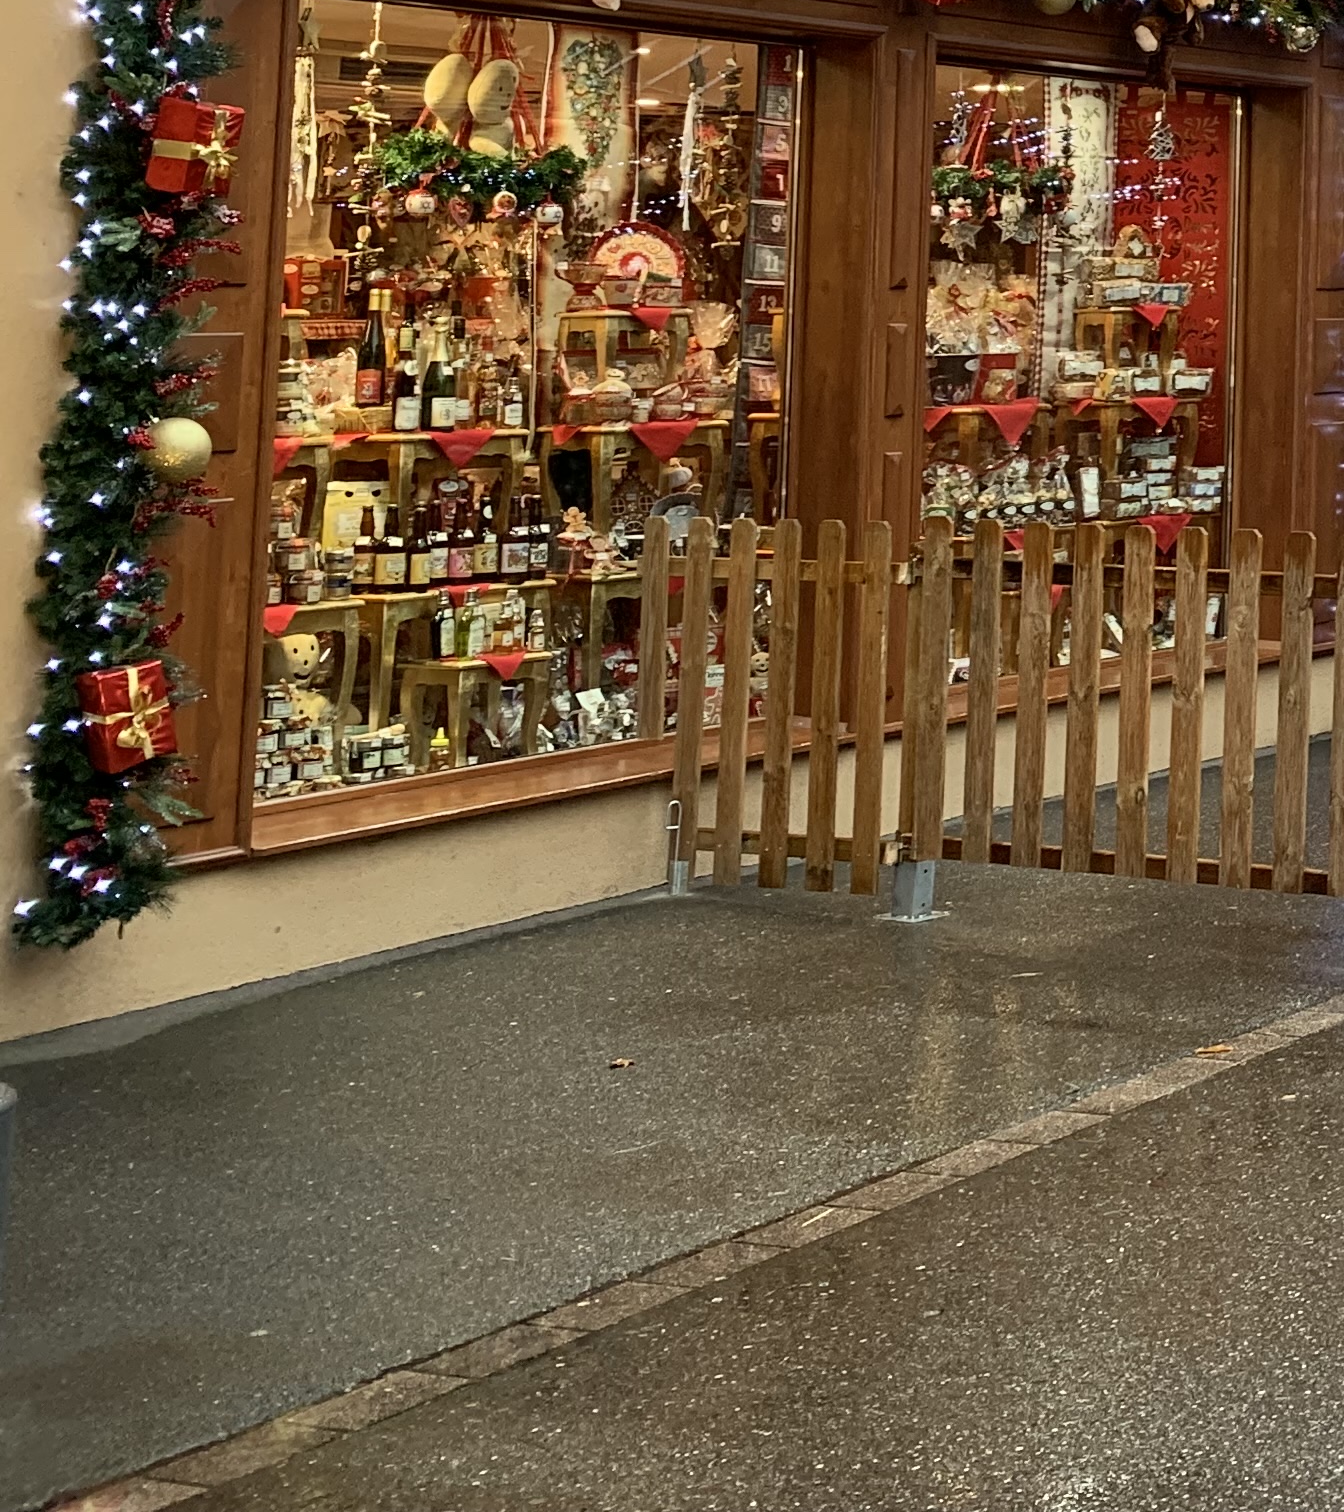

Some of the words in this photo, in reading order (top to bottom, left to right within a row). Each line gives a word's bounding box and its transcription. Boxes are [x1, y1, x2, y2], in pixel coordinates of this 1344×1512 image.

[783, 54, 792, 72] 1
[775, 133, 788, 152] 5
[770, 214, 783, 233] 9
[763, 254, 780, 273] 11
[757, 294, 777, 312] 13
